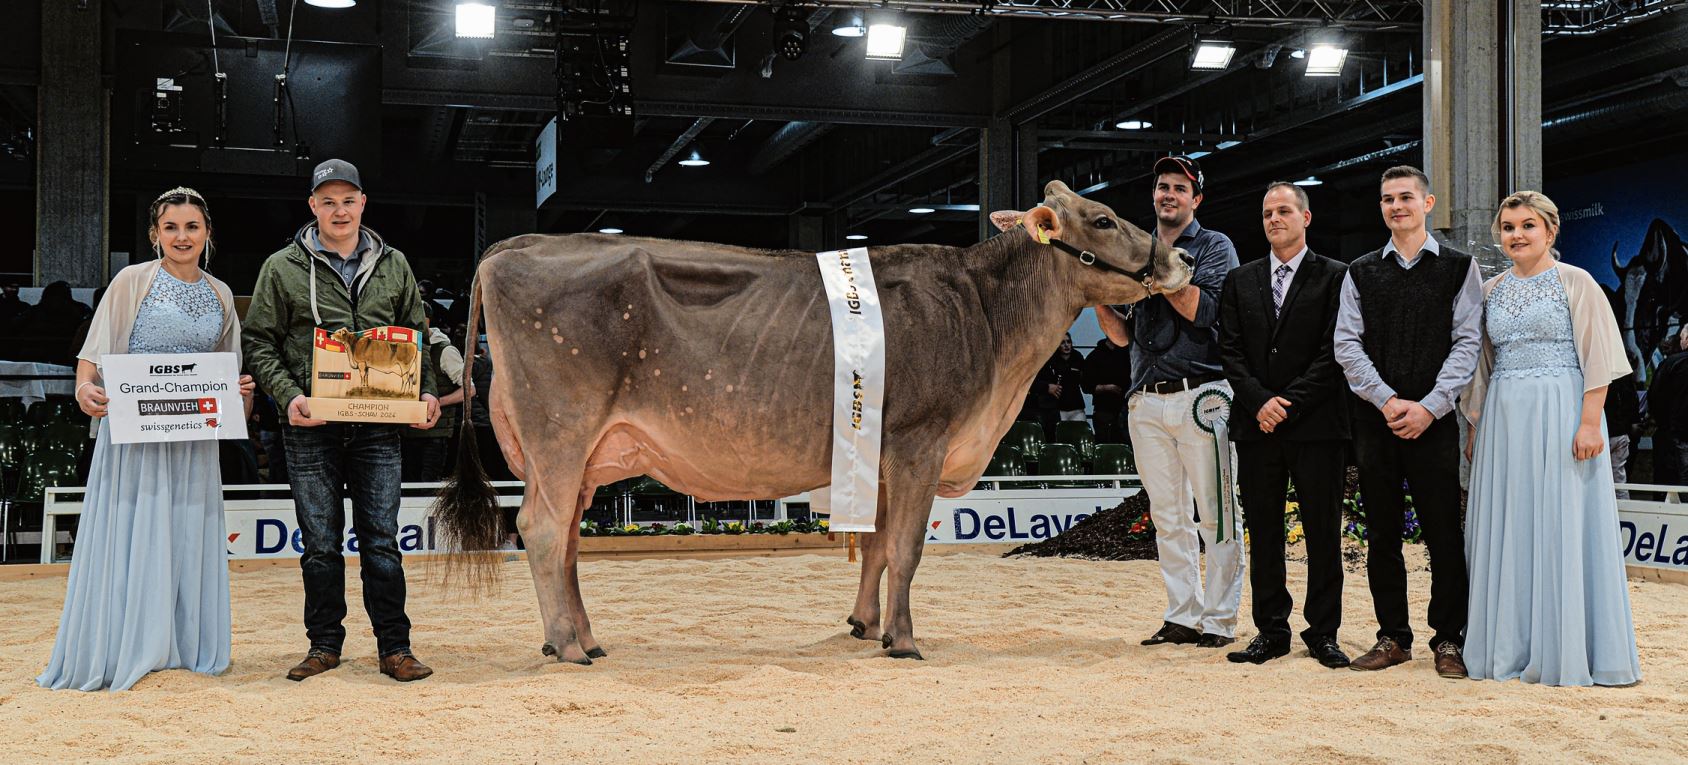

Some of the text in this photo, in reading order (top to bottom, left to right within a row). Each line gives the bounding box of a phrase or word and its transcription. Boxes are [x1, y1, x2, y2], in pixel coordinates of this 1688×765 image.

[149, 365, 181, 374] IGBS
[120, 381, 228, 394] Grand-Champion
[140, 404, 199, 413] BRAUNVIEH
[347, 403, 390, 411] CHAMPION
[140, 421, 203, 433] swissgenetics
